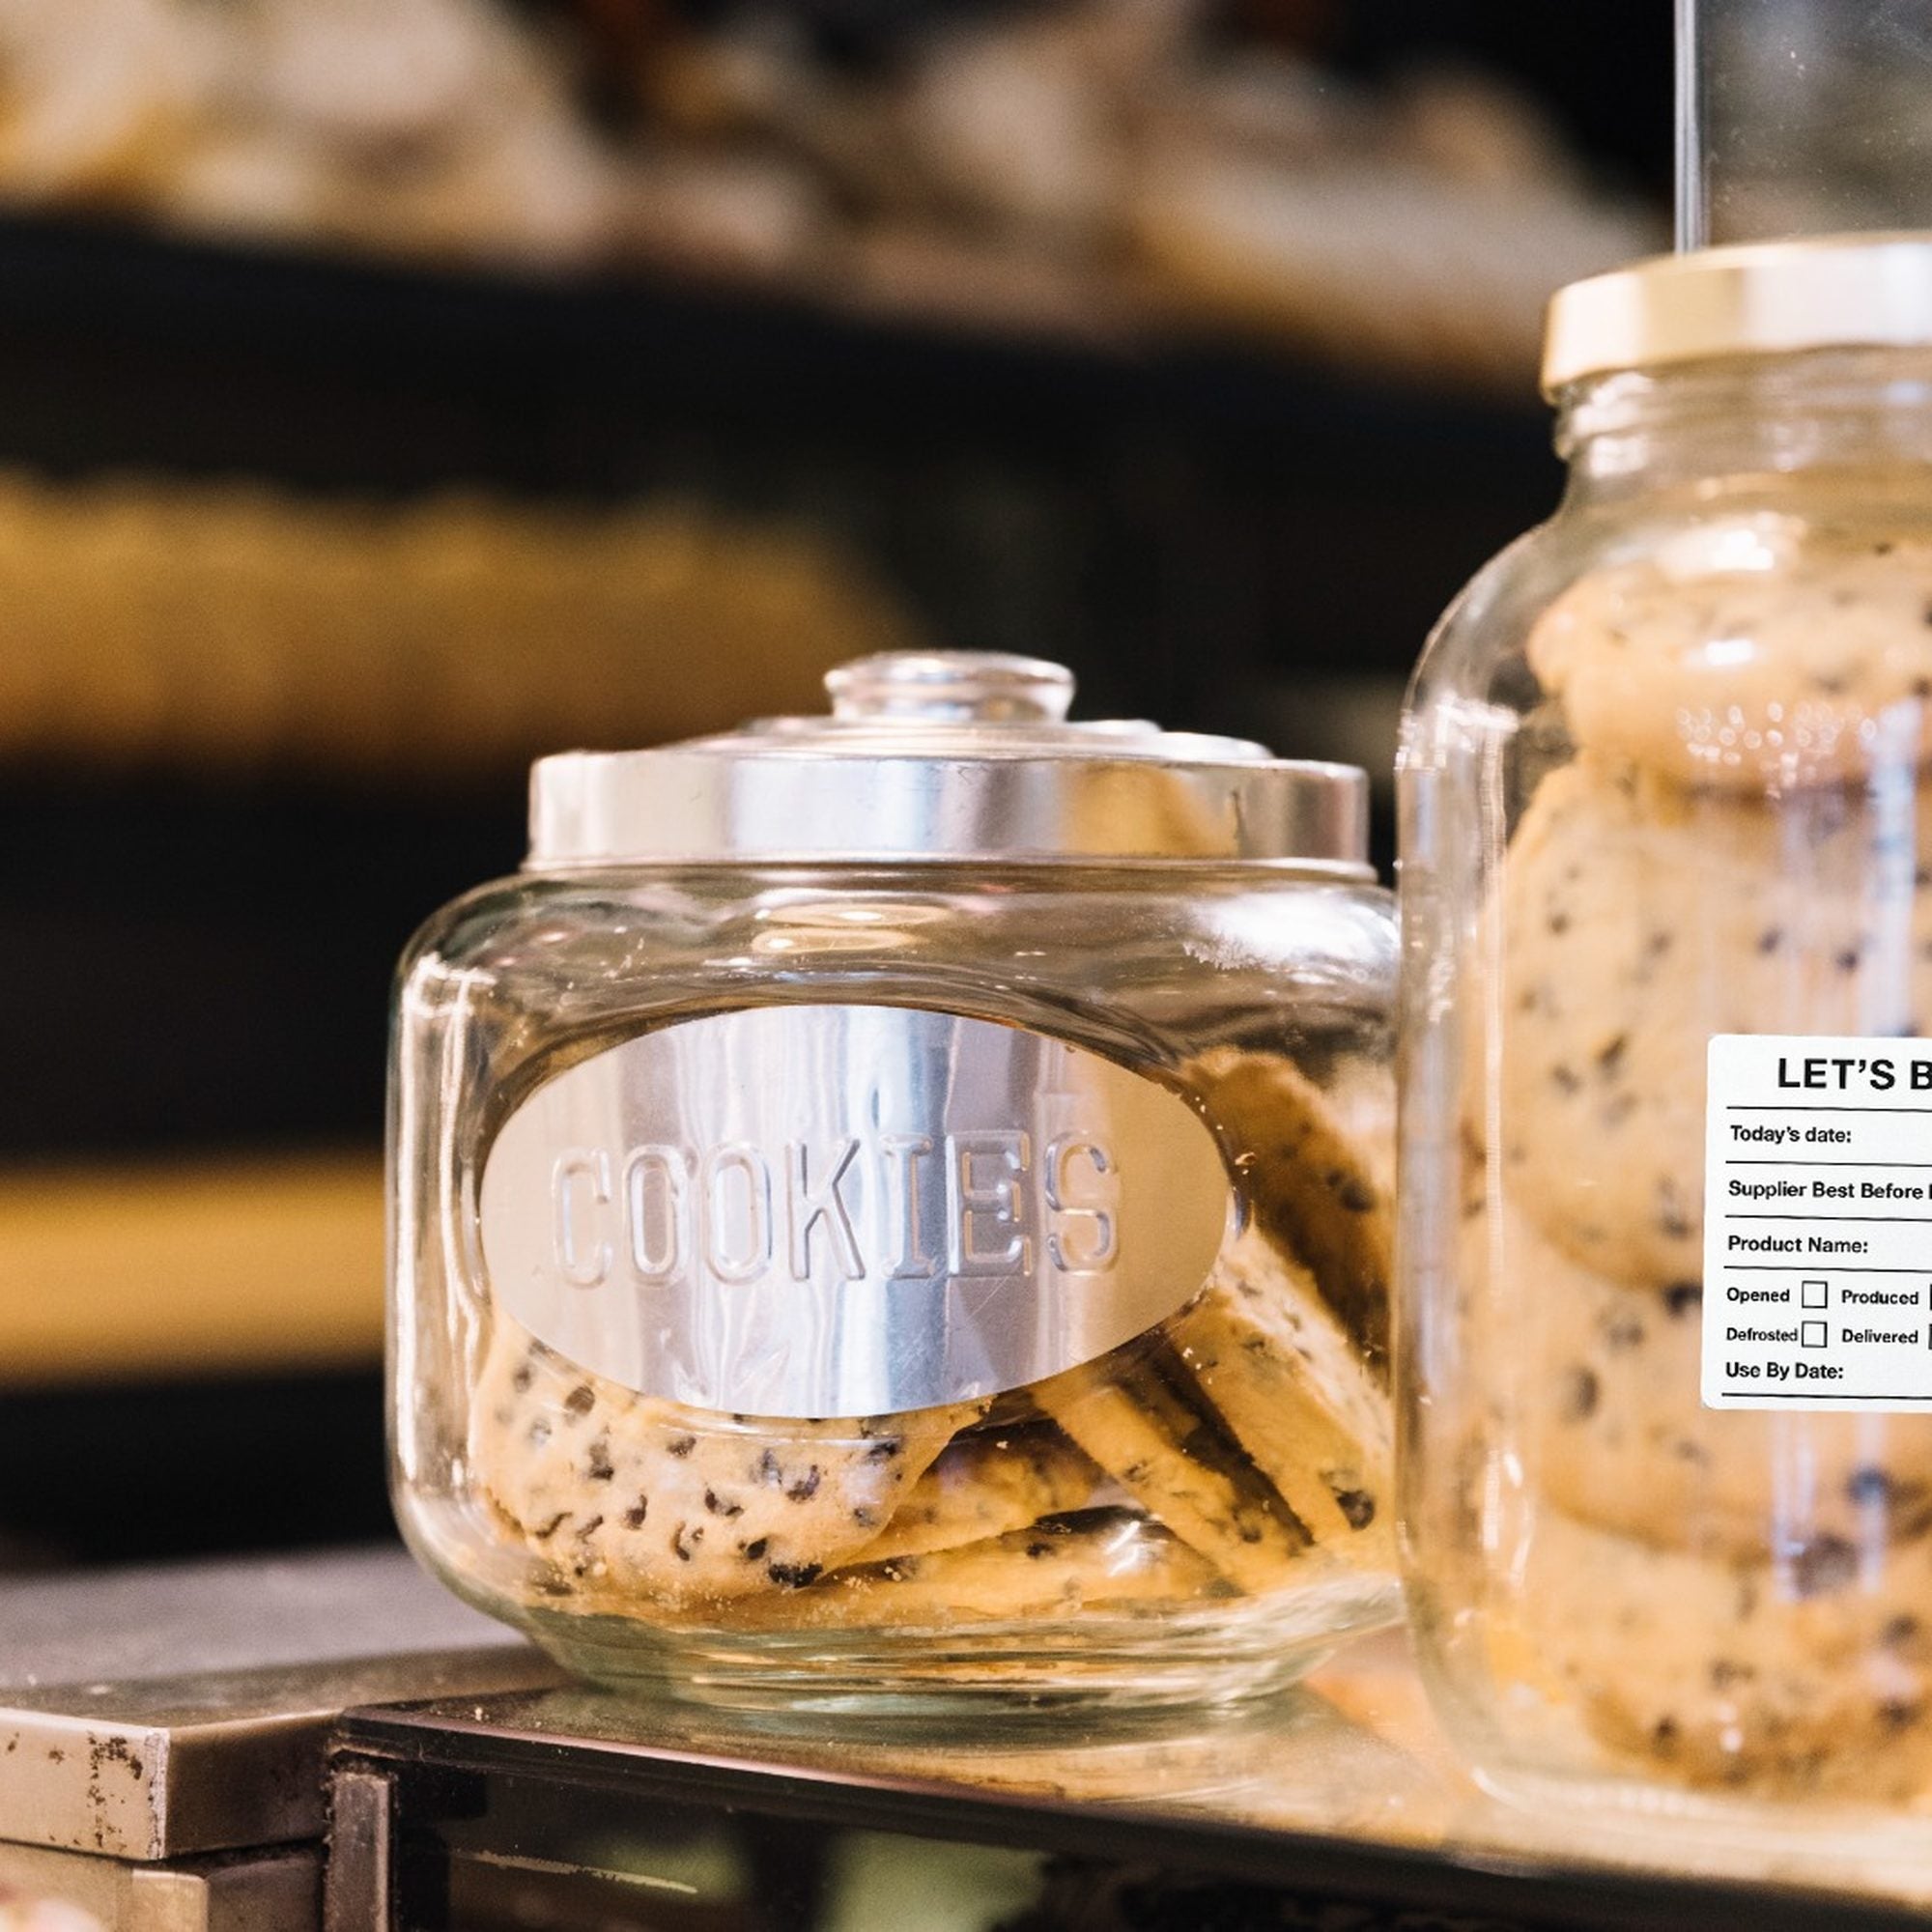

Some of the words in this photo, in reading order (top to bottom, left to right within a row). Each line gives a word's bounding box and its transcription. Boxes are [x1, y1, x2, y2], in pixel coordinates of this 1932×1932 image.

[1777, 1057, 1896, 1092] LET’S
[1730, 1124, 1801, 1145] Today’s
[1804, 1126, 1852, 1144] date:
[1728, 1179, 1807, 1201] Supplier
[1812, 1180, 1856, 1199] Best
[1861, 1182, 1924, 1200] Before
[553, 1130, 1120, 1288] COOKIES
[1728, 1235, 1803, 1253] Product
[1807, 1236, 1868, 1254] Name:
[1726, 1287, 1791, 1305] Opened
[1841, 1289, 1919, 1305] Produced
[1726, 1326, 1799, 1342] Defrosted
[1841, 1328, 1918, 1344] Delivered
[1725, 1361, 1761, 1378] Use
[1766, 1361, 1790, 1381] By
[1795, 1362, 1844, 1379] Date:
